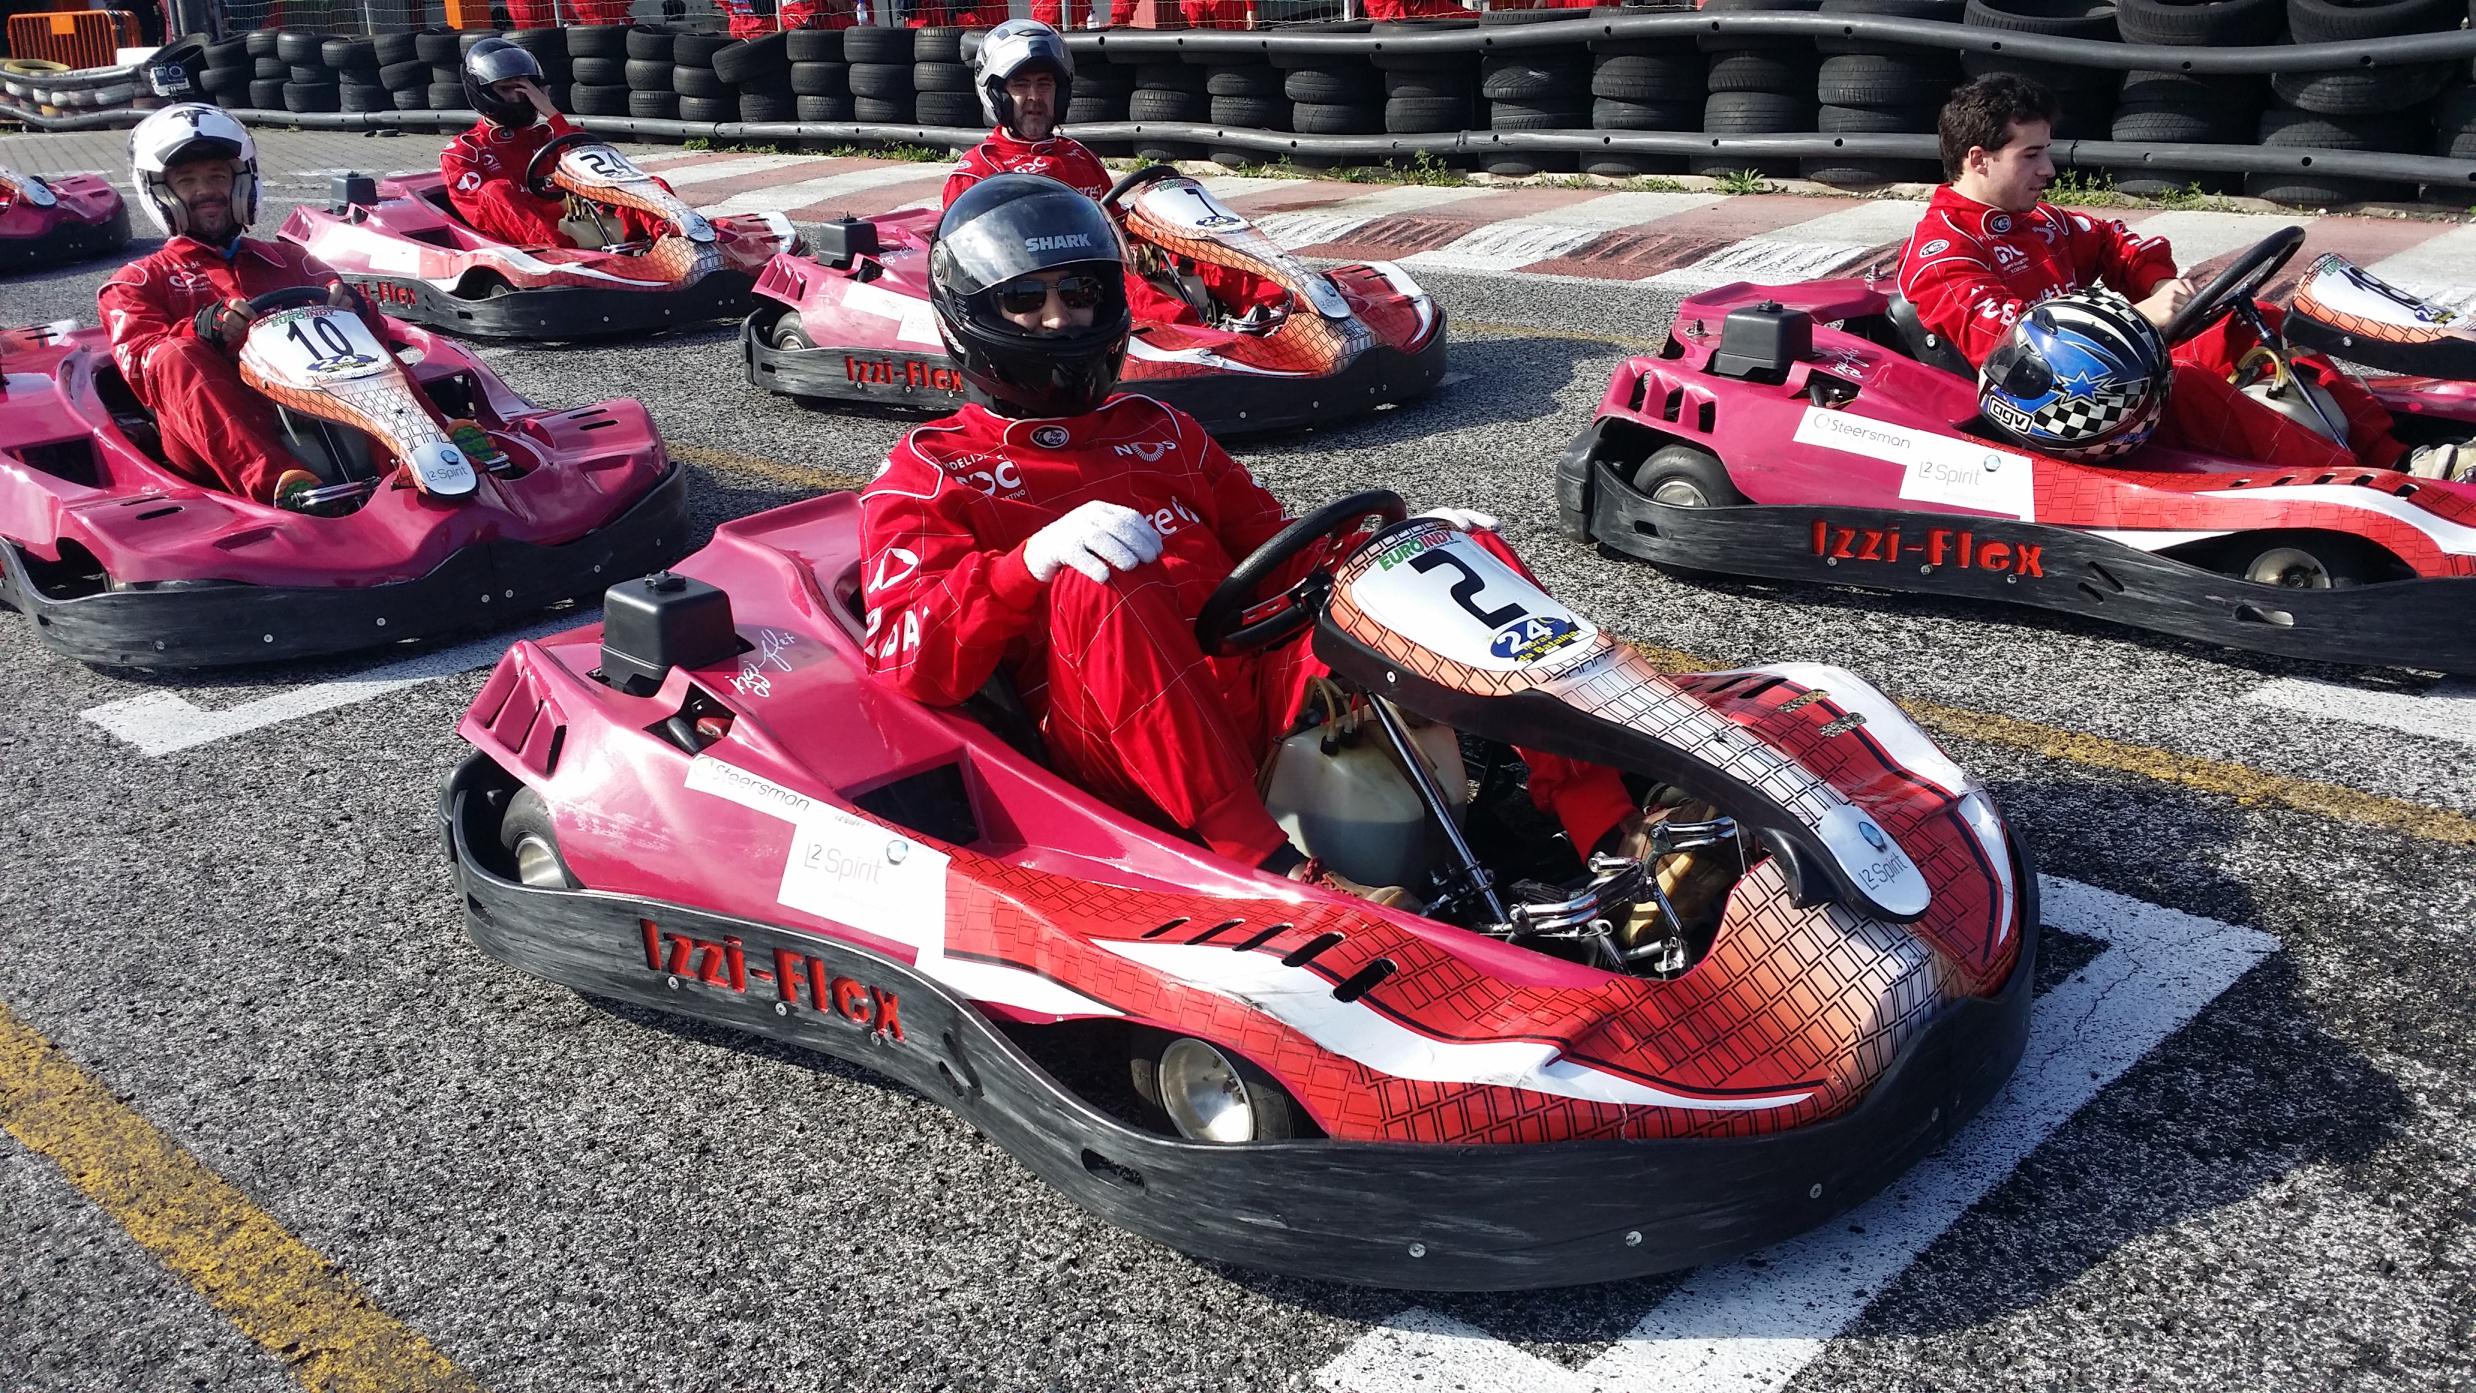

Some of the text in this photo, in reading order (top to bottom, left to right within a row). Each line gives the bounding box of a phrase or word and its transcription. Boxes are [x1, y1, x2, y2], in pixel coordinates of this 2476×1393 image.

[579, 152, 634, 176] 24
[1184, 188, 1222, 217] 7
[1024, 233, 1092, 253] SHARK
[2340, 265, 2424, 311] 18
[271, 310, 334, 328] EUROINDY
[286, 316, 355, 360] 10
[844, 355, 964, 393] Izzi-Flex
[1991, 401, 2029, 430] agv
[1831, 418, 1911, 449] Steersman
[437, 466, 468, 481] Spirit
[1935, 463, 1982, 486] Spirit
[1378, 530, 1455, 572] EUROINDY
[1812, 519, 2044, 578] Izzi-Flex
[1407, 549, 1529, 630] 2
[1495, 619, 1554, 655] 24
[1533, 631, 1578, 654] Batalha
[713, 763, 810, 812] Steersman
[824, 847, 883, 885] Spirit
[1871, 851, 1909, 884] Spirit
[639, 917, 907, 1044] Izzi-Flex
